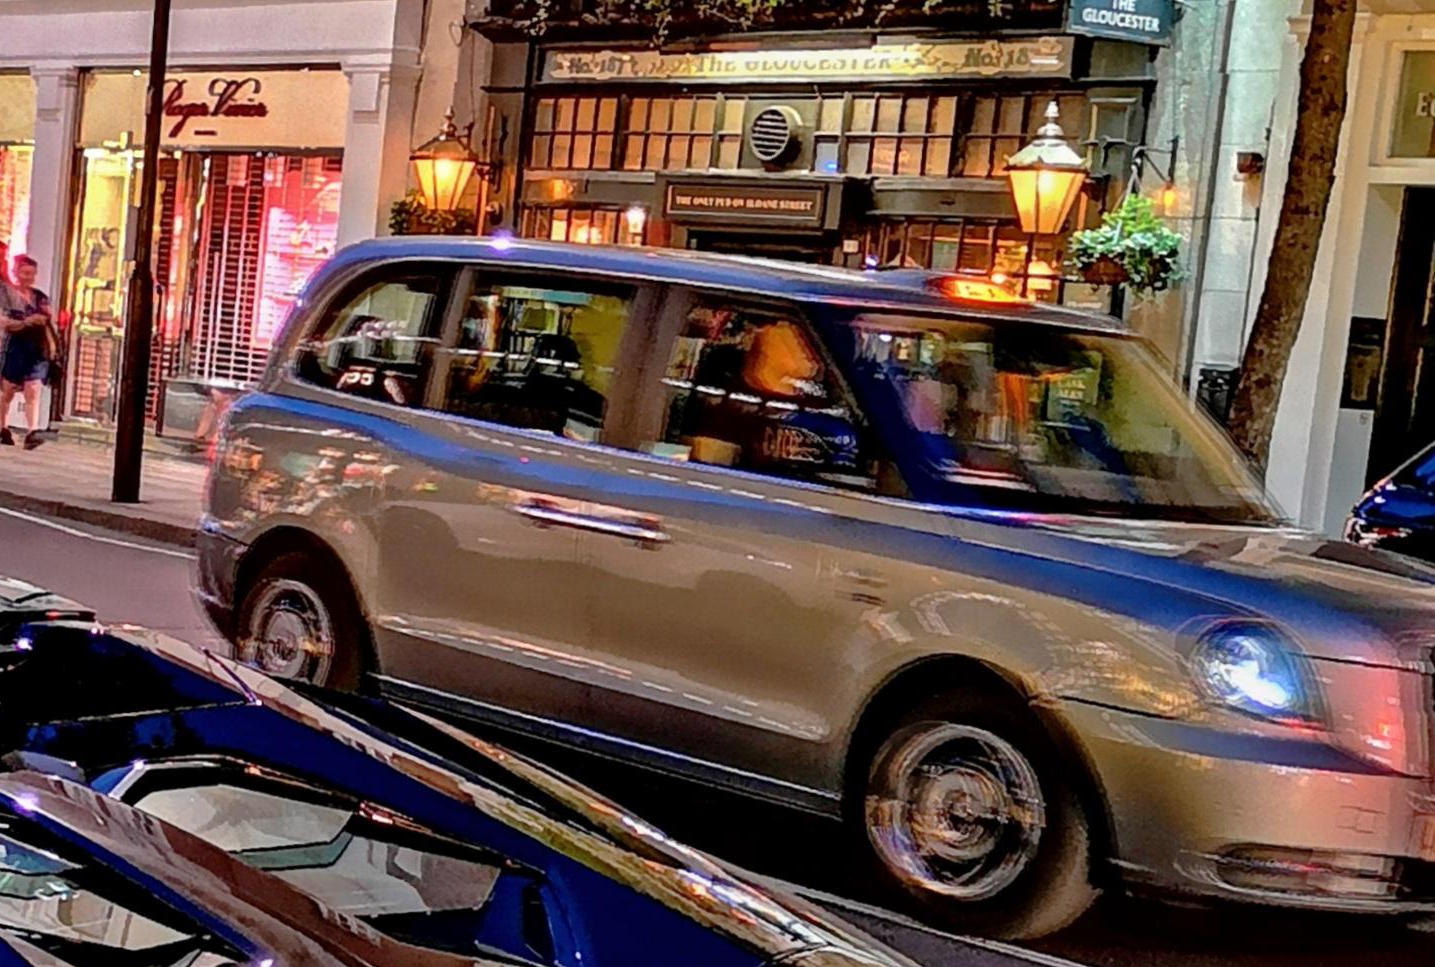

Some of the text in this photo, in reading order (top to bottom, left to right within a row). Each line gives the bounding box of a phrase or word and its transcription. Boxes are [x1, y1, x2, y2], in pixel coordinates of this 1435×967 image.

[1112, 0, 1136, 12] THE
[1081, 7, 1161, 33] GLOUCESTER
[675, 195, 692, 206] THE
[692, 196, 715, 207] ONLY
[746, 198, 779, 210] SLOANE
[779, 199, 814, 211] STREET
